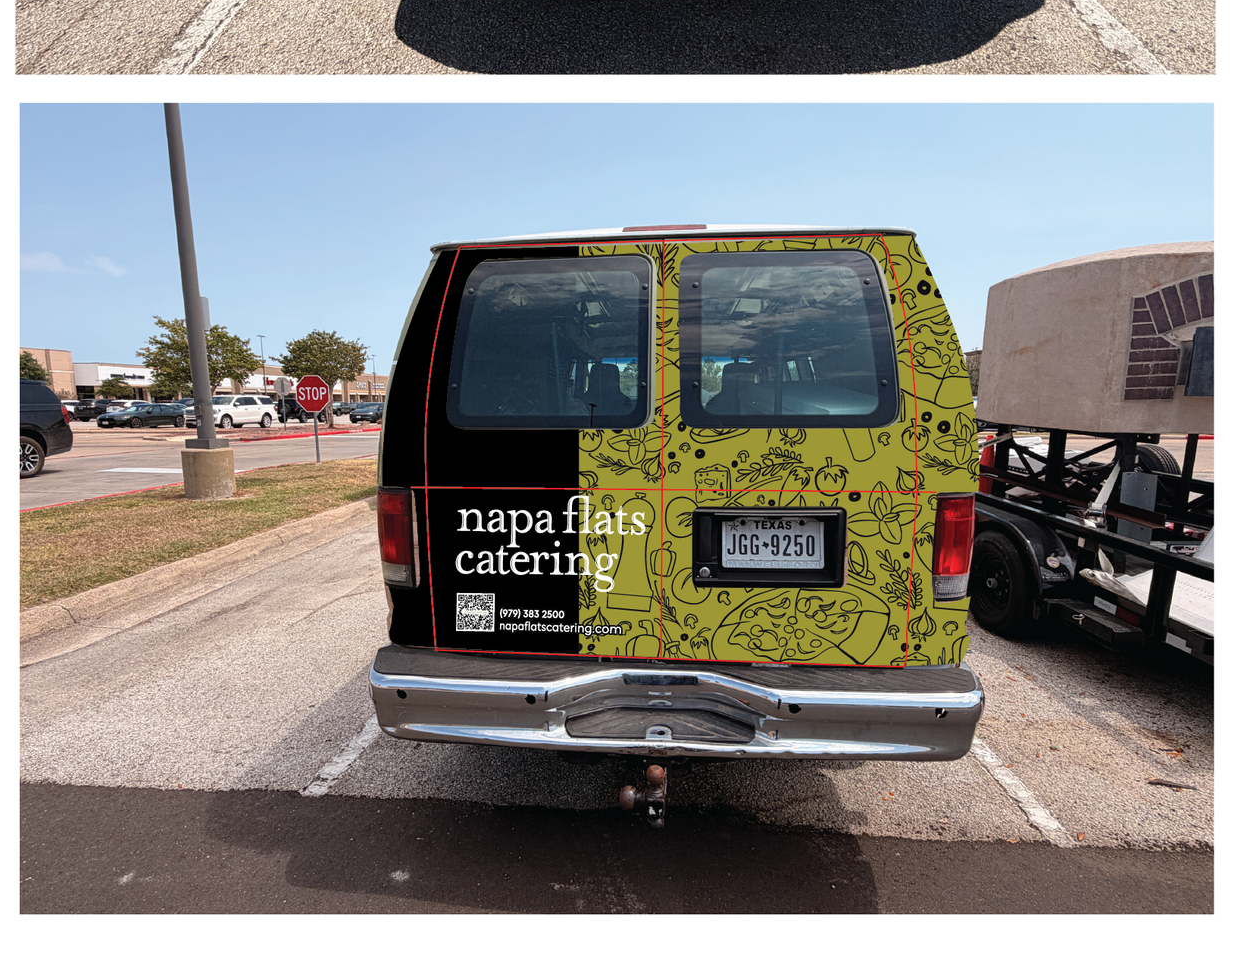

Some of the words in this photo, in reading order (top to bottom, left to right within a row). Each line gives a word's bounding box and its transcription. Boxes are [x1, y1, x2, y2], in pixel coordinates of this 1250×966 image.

[298, 386, 327, 401] STOP
[456, 506, 556, 550] napa
[561, 496, 647, 536] flats
[753, 520, 792, 530] TEXAS
[727, 533, 760, 556] JGG
[770, 534, 816, 557] 9250
[455, 541, 619, 592] catering
[499, 608, 521, 619] (979)
[522, 609, 540, 619] 383
[541, 610, 565, 620] 2500
[499, 621, 622, 636] napaflatscatering.com
